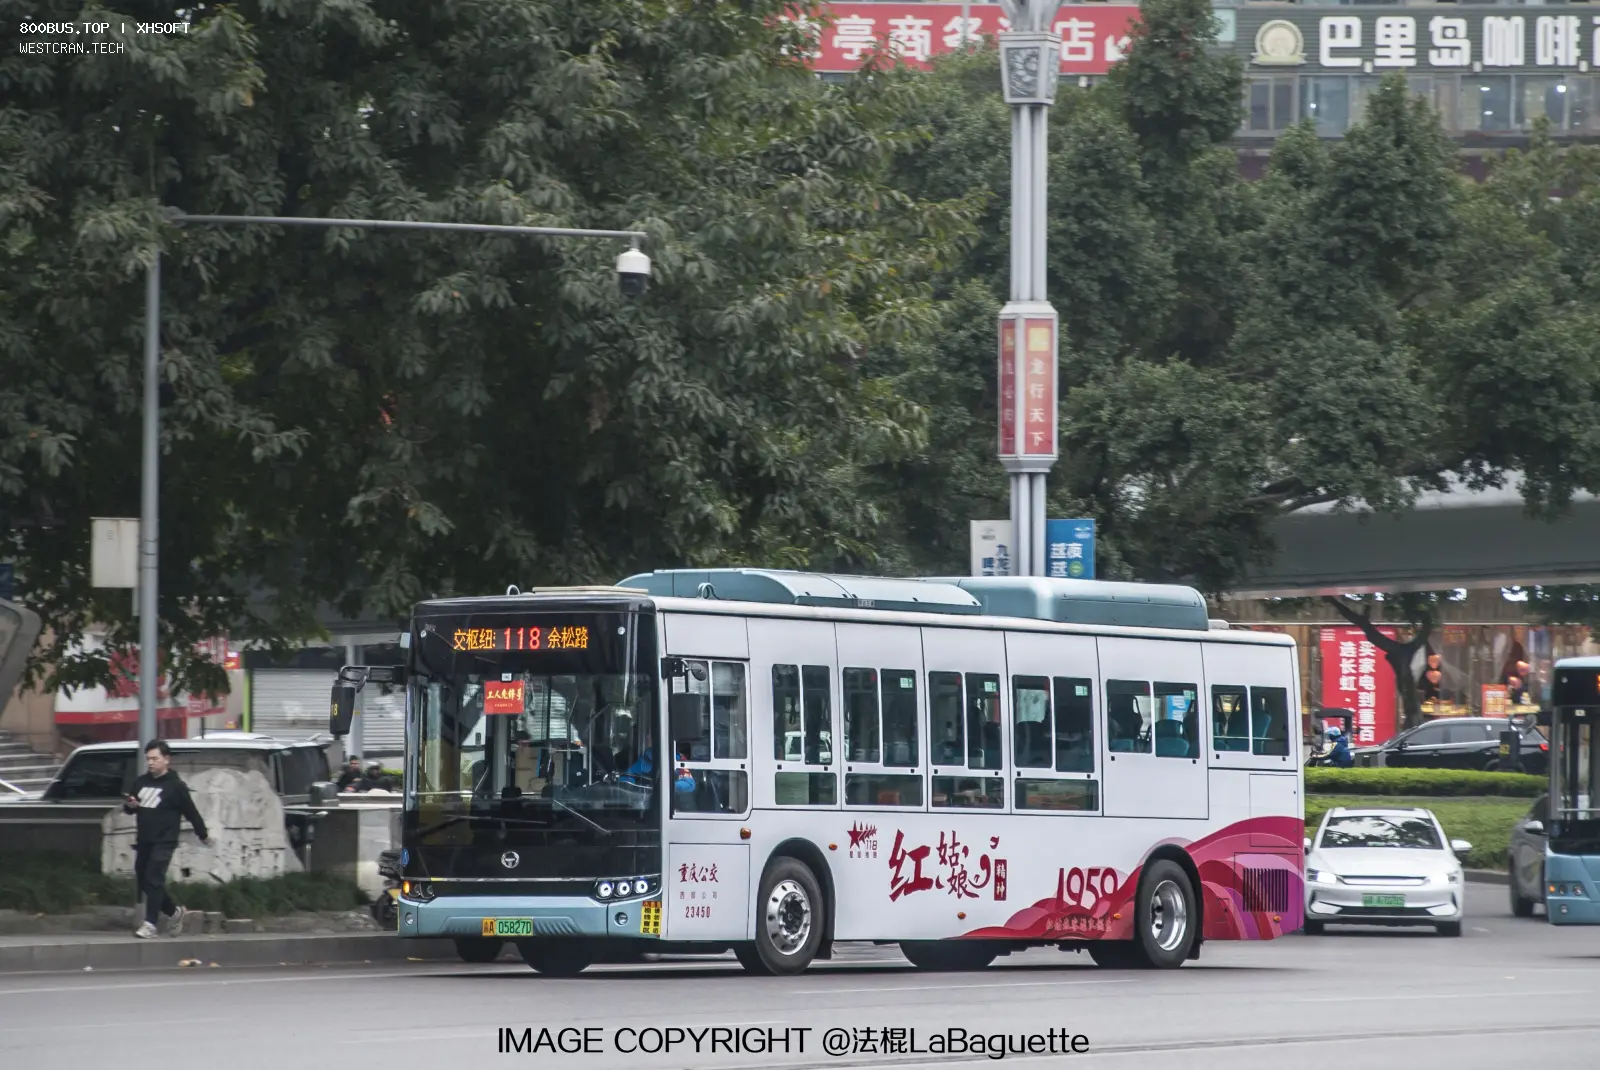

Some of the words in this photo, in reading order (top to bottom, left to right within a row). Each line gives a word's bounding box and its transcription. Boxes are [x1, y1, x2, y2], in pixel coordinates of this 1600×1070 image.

[1319, 16, 1600, 67] 巴里岛咖啡
[453, 628, 496, 650] 交枢纽
[504, 627, 541, 650] 118
[547, 626, 588, 649] 余松路
[678, 863, 719, 883] 重庆公交
[889, 829, 991, 902] 红姑娘
[1056, 866, 1119, 912] 1950
[685, 906, 711, 918] 23450
